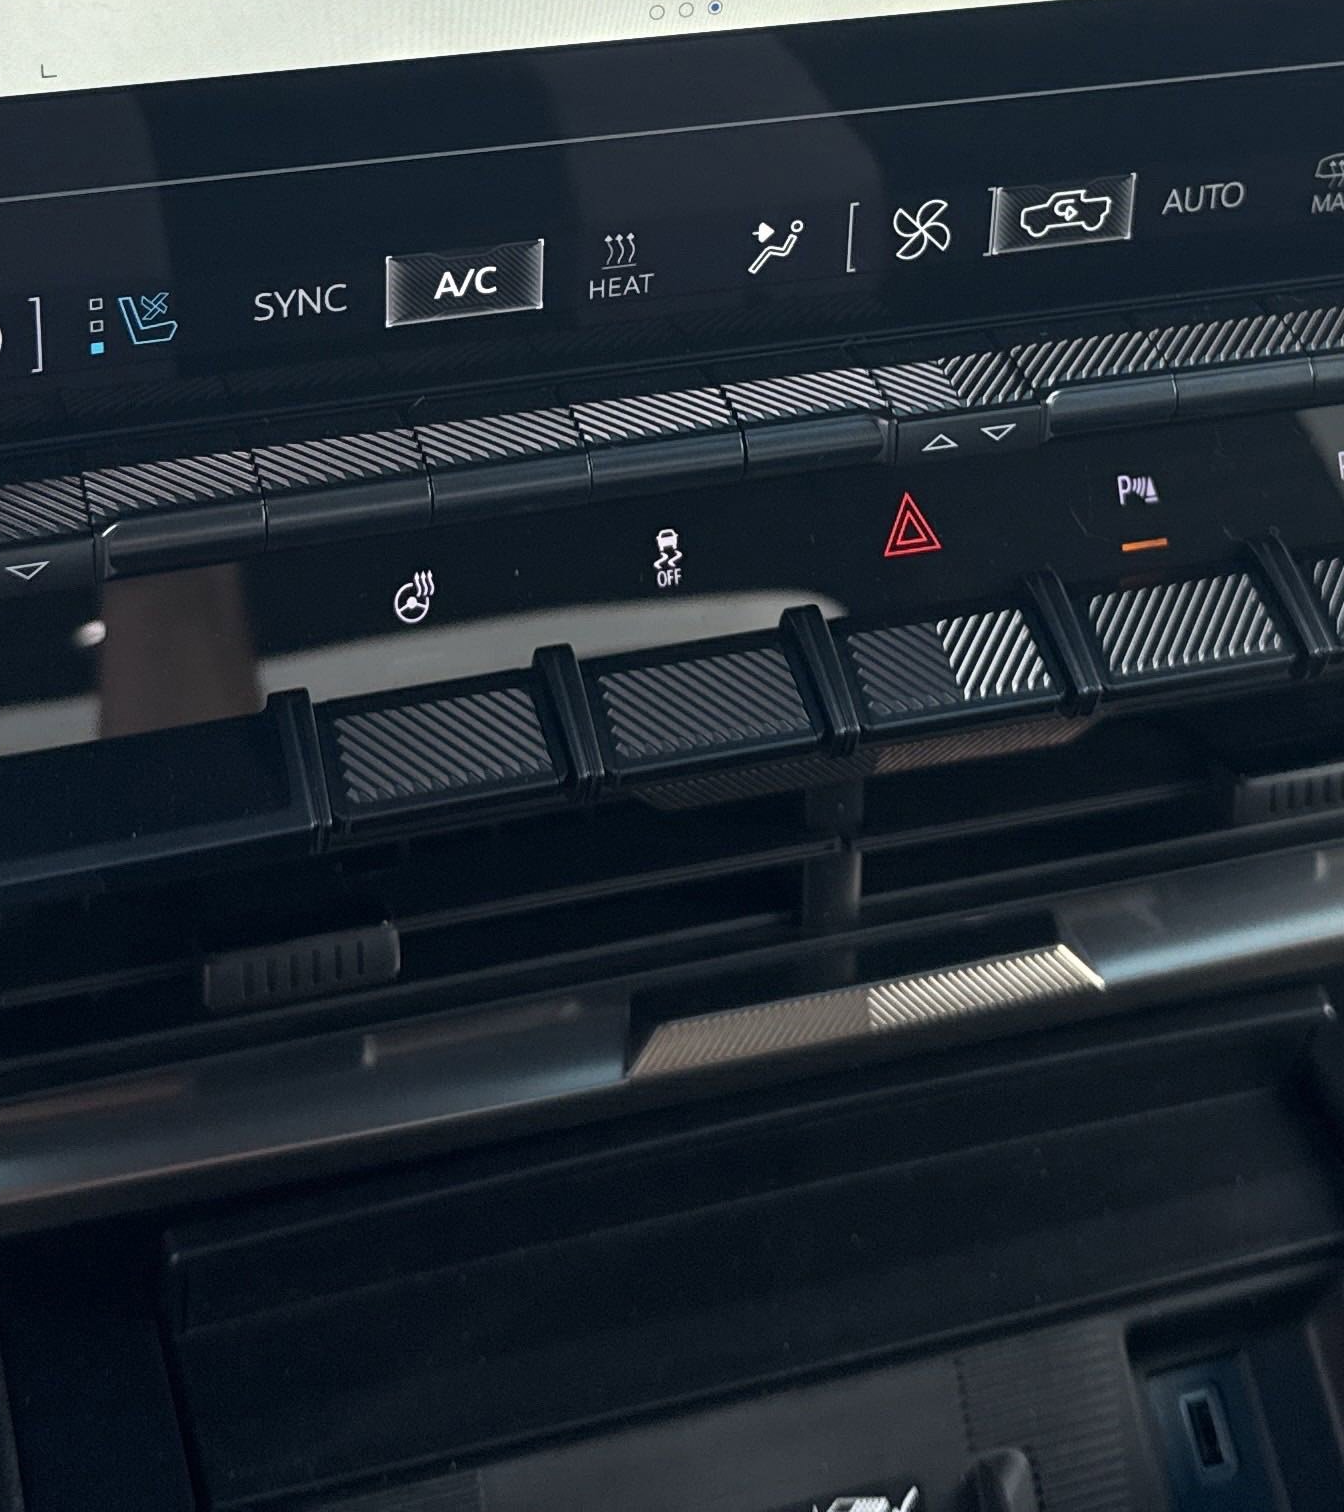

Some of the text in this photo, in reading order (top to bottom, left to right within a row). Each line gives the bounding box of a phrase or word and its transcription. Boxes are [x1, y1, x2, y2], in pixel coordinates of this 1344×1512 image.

[1161, 181, 1246, 216] AUTO
[433, 265, 498, 301] A/C
[588, 271, 656, 301] HEAT
[253, 282, 348, 323] SYNC
[654, 565, 682, 589] OFF
